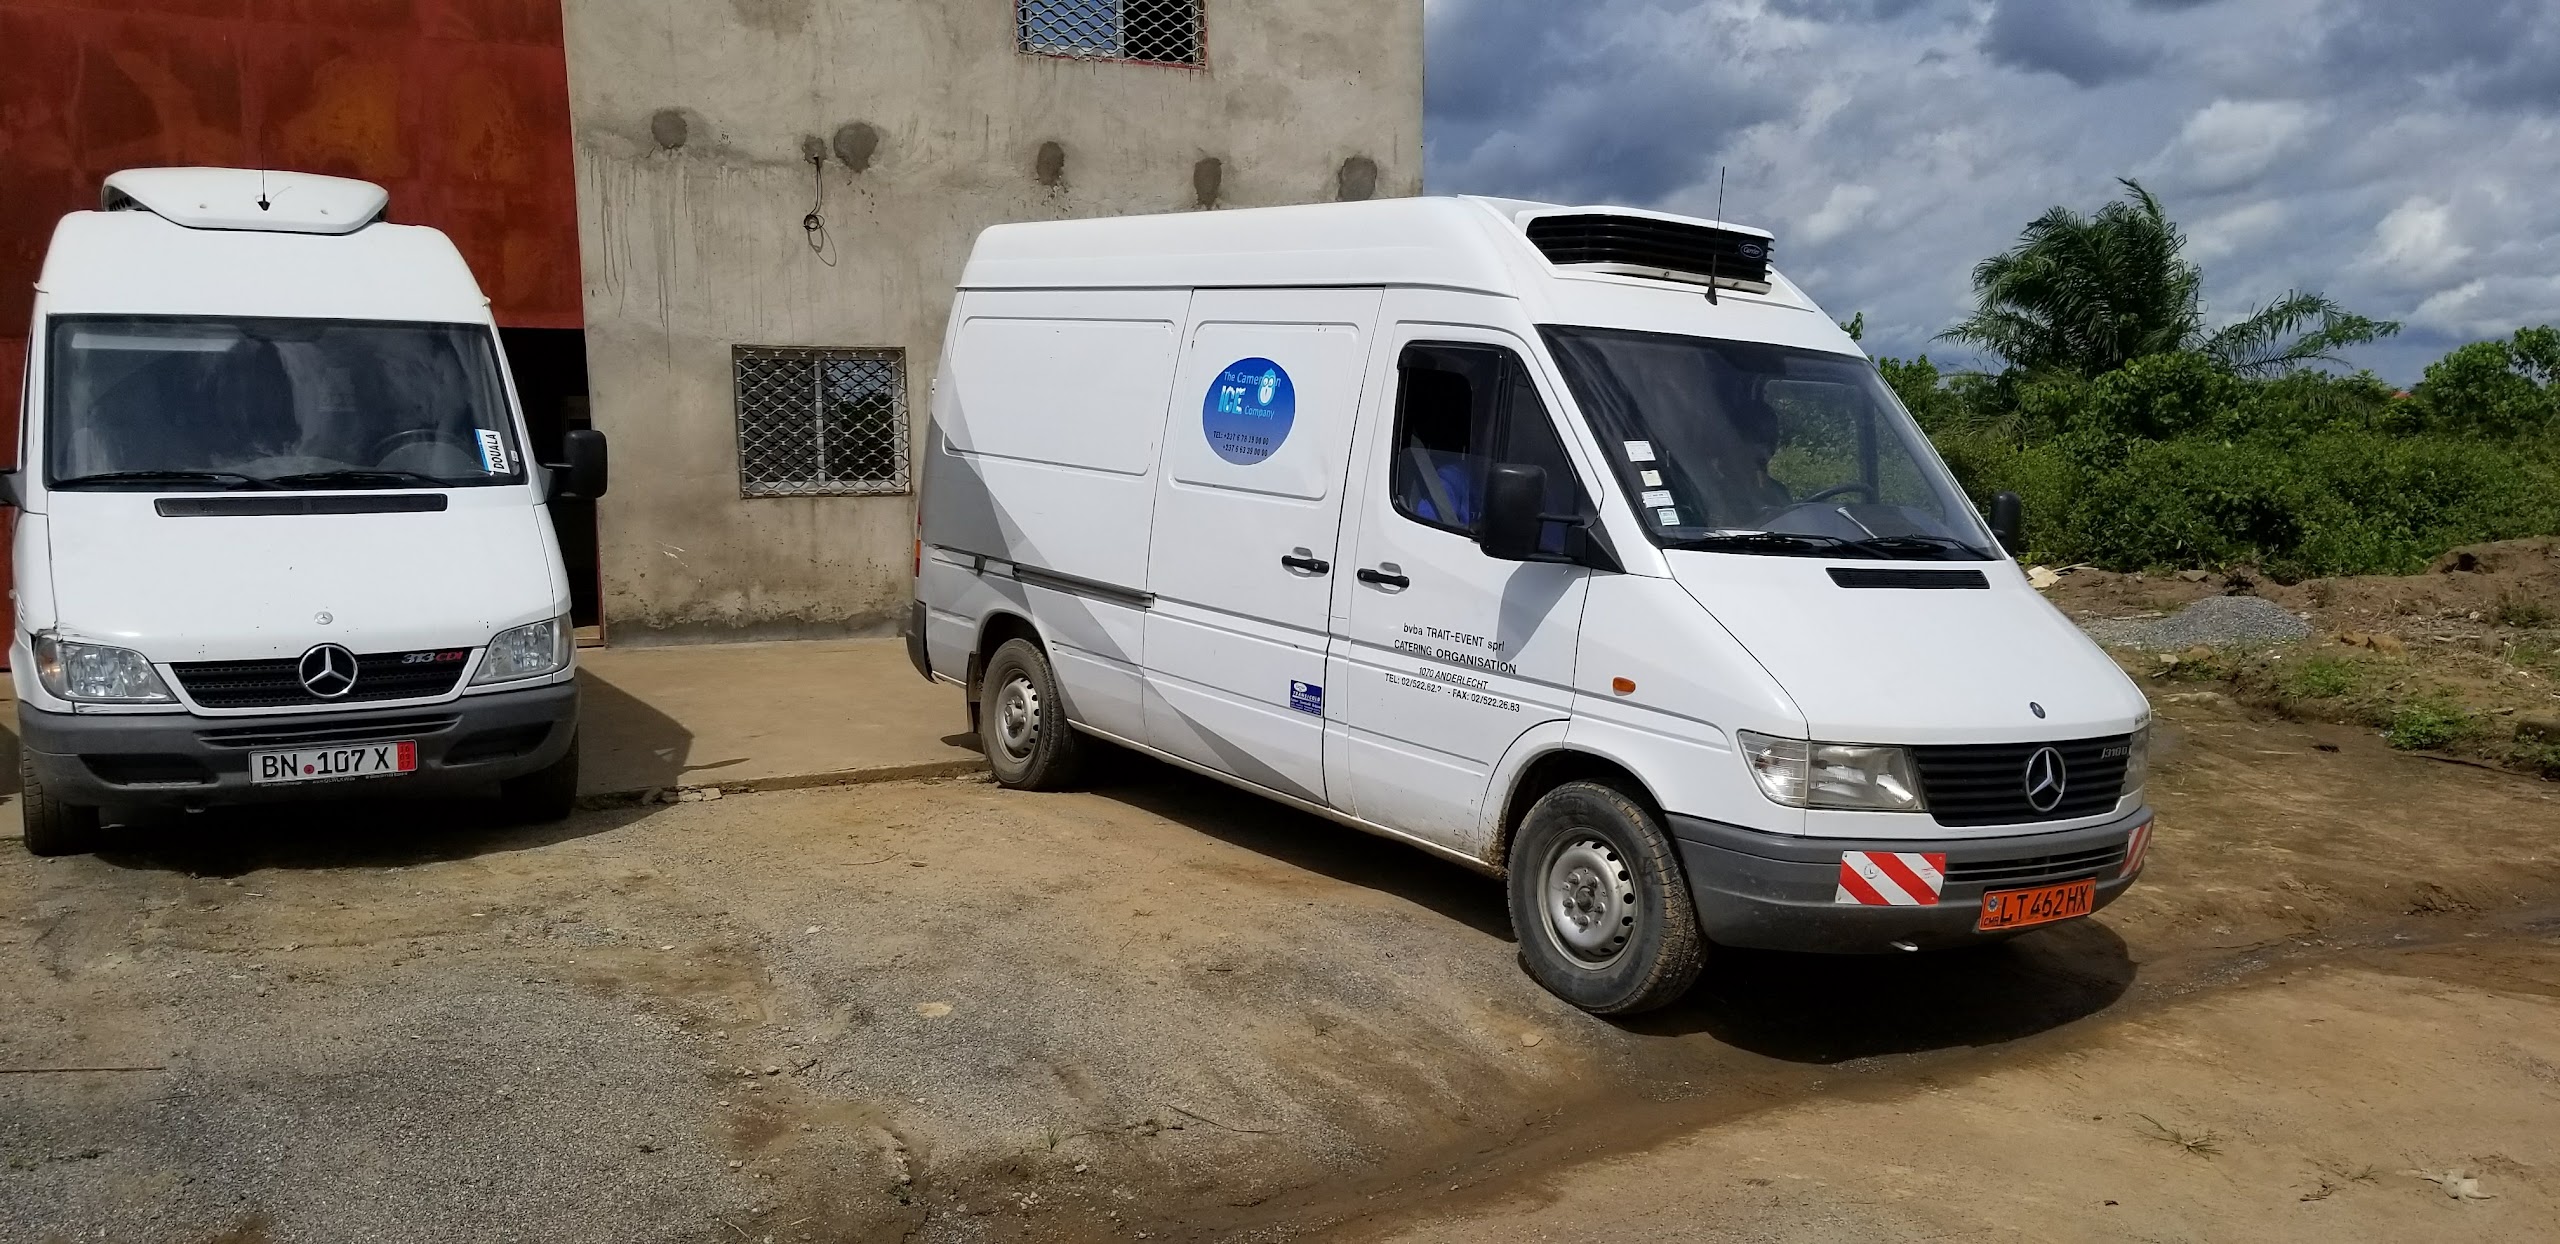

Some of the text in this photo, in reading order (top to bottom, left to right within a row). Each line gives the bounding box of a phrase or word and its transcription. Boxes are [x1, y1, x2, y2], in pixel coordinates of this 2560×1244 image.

[1224, 371, 1236, 382] The
[1218, 385, 1246, 415] ICE
[1244, 405, 1275, 420] Company
[485, 434, 505, 470] DOUALA
[1403, 622, 1505, 652] bvba TRAIT-EVENT sprl
[401, 651, 464, 664] 313 CDI
[1394, 639, 1517, 675] CATERING ORGANISATION
[1384, 673, 1400, 685] TEL:
[1452, 689, 1470, 701] FAX:
[1418, 667, 1489, 690] 1070 ANDERLECHT
[262, 746, 390, 779] BN 107 X
